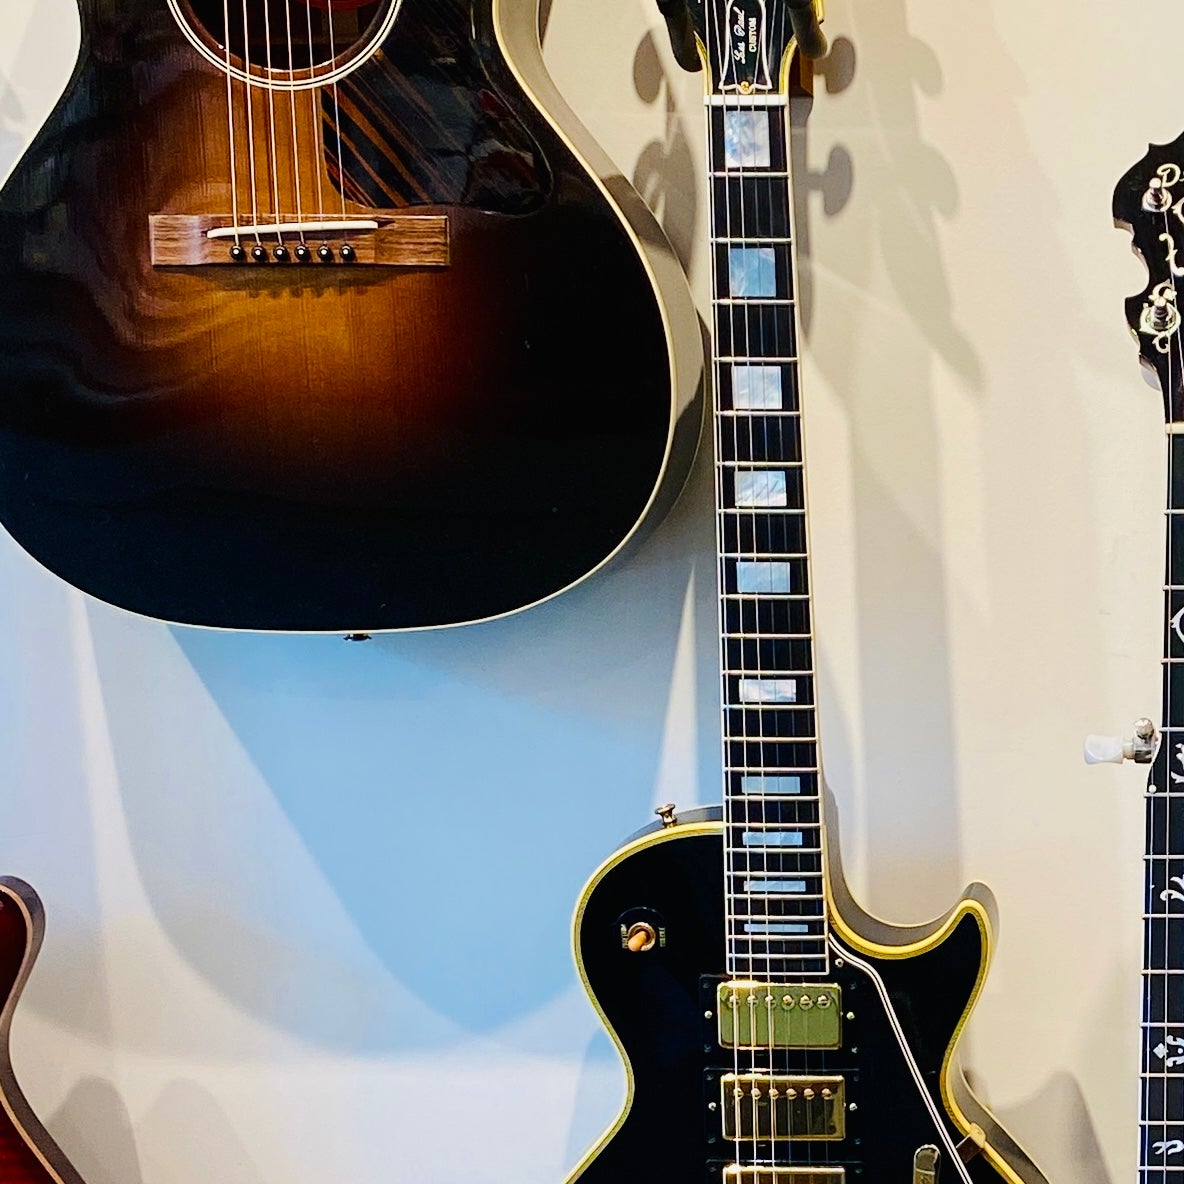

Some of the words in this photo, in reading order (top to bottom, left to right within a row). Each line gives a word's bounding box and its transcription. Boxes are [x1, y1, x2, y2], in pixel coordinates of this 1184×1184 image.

[733, 6, 746, 37] Paul
[748, 17, 757, 53] CUSTOM
[733, 41, 746, 65] Les
